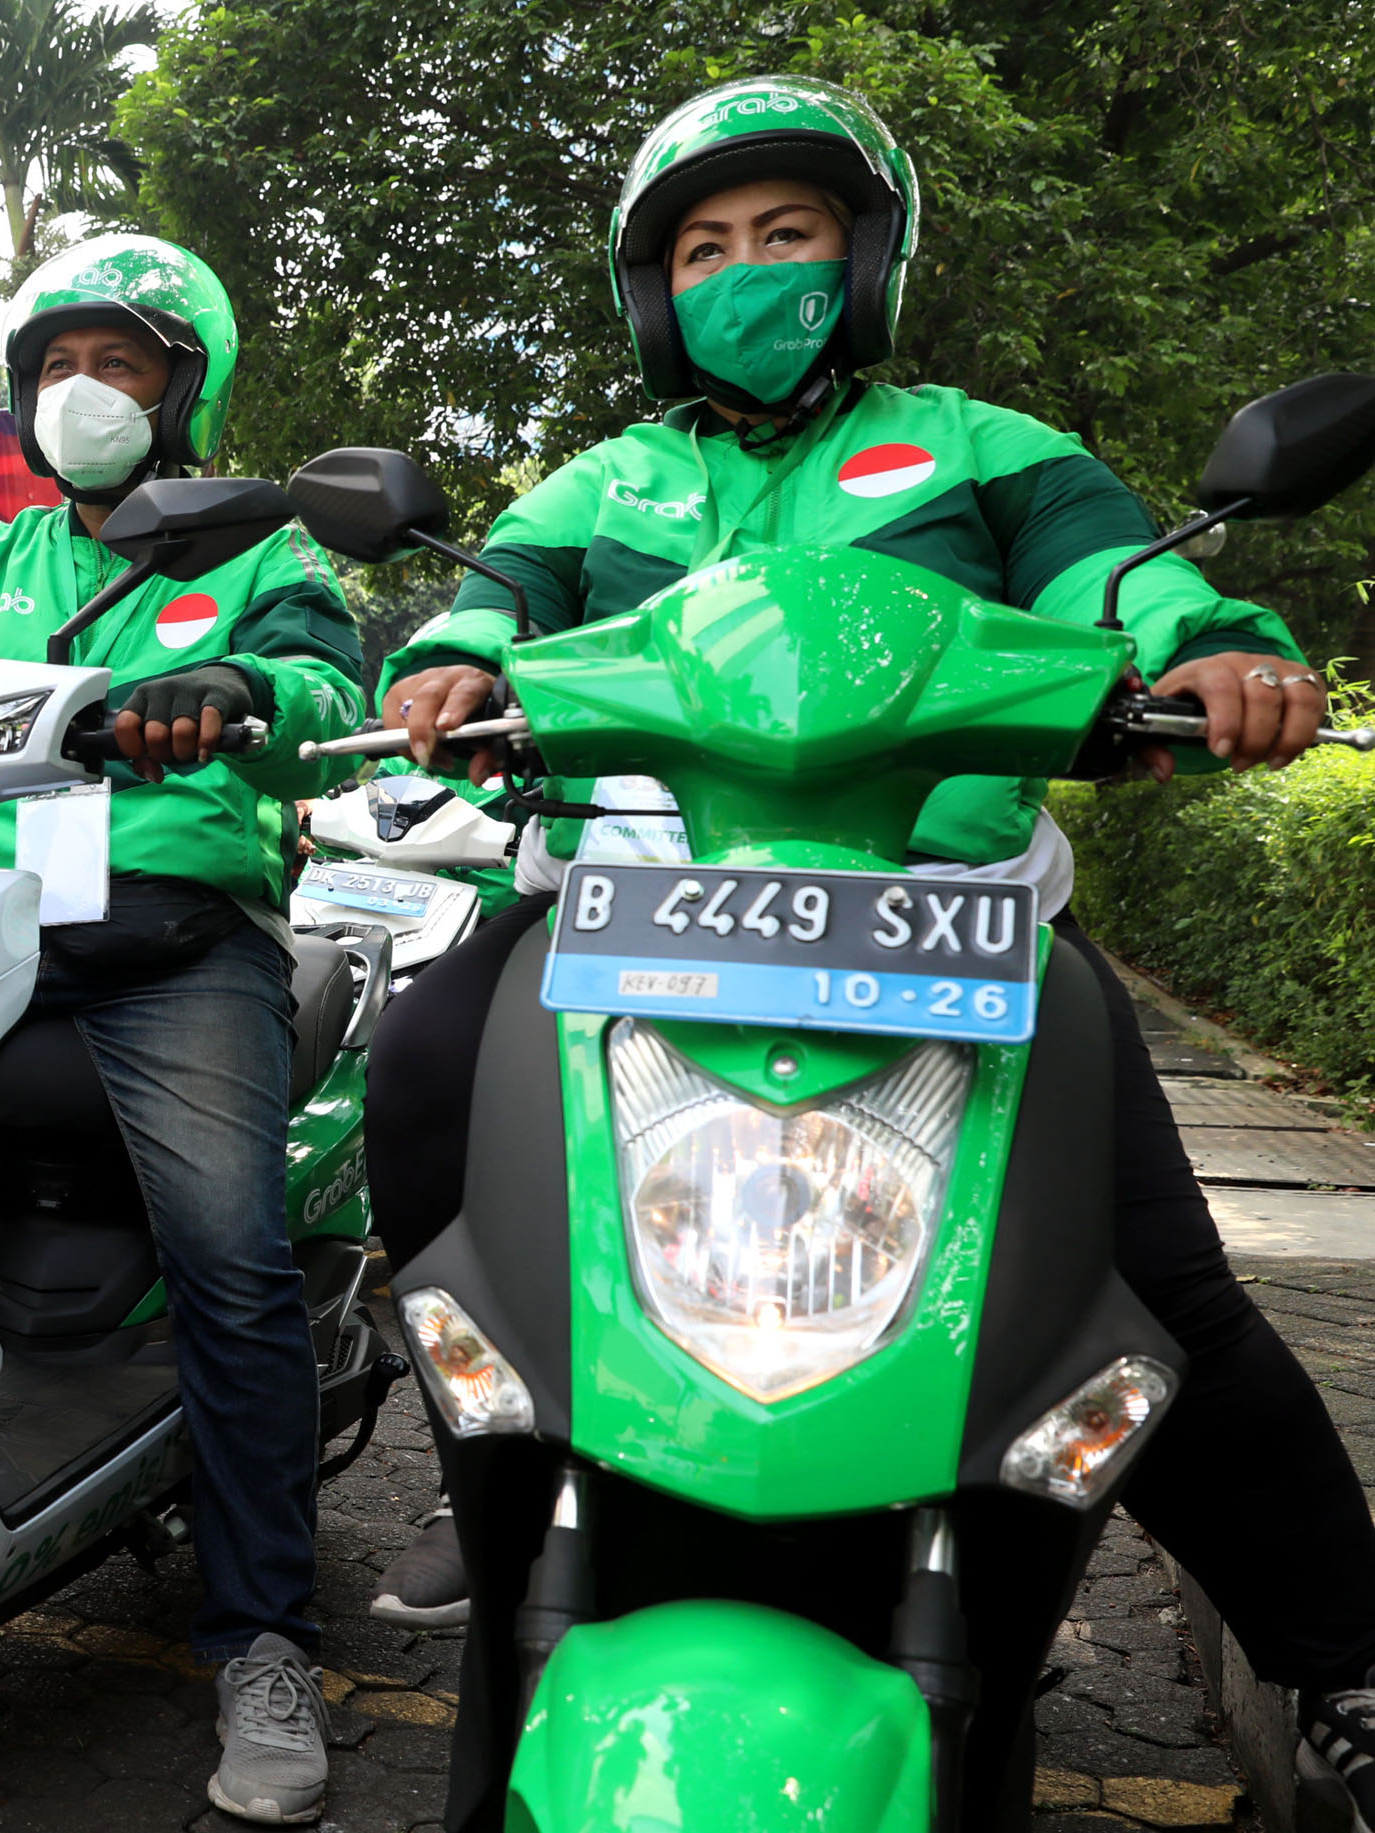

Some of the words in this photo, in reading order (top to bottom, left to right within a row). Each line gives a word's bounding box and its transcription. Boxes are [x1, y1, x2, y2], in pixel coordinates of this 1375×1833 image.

[600, 824, 689, 843] COMMITTE
[309, 869, 337, 886] DK
[341, 874, 394, 894] 2513
[575, 875, 615, 931] B
[653, 878, 830, 942] 4449
[873, 885, 1017, 954] SXU
[304, 1146, 365, 1224] GrabE
